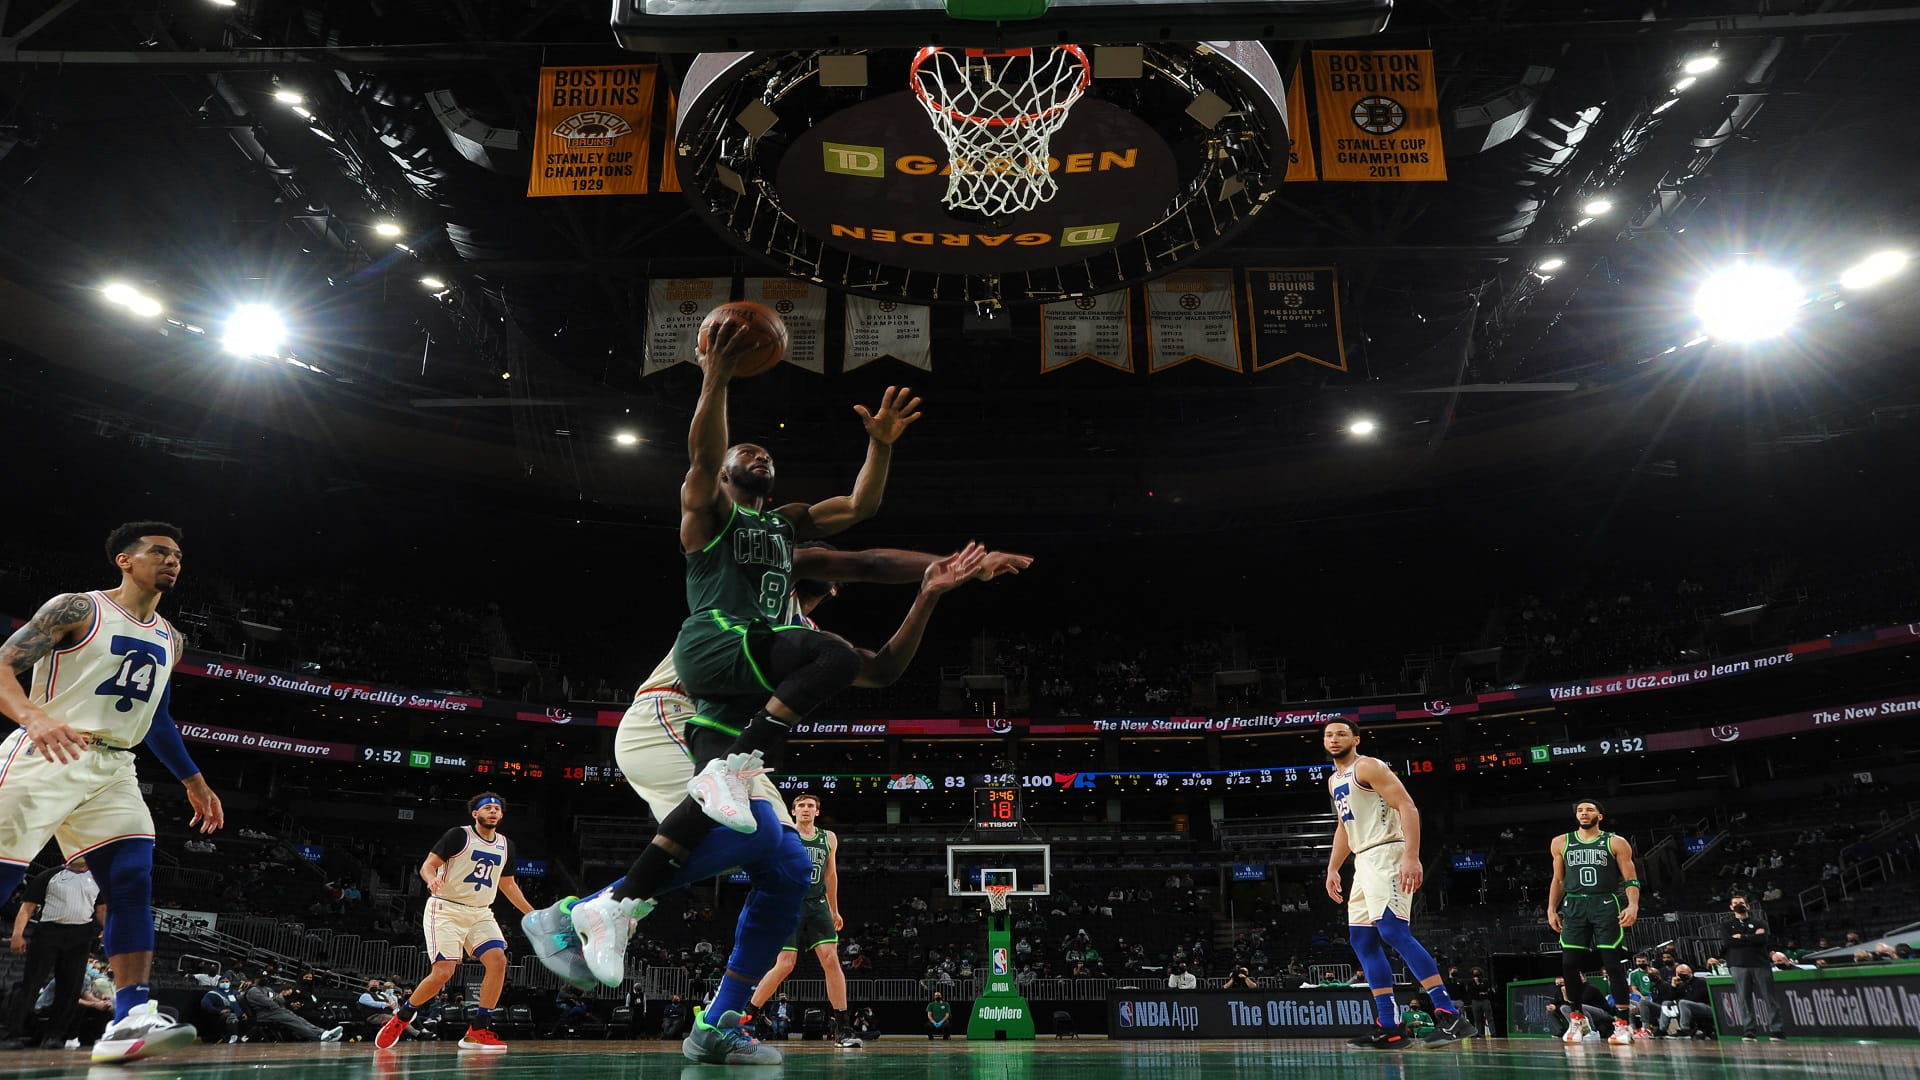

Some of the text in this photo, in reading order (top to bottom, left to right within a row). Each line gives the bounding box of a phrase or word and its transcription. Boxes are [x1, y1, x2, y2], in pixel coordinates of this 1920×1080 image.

[1329, 54, 1419, 72] BOSTON
[555, 69, 641, 87] BOSTON
[1331, 73, 1421, 92] BRUINS
[552, 87, 639, 107] BRUINS
[556, 112, 630, 136] BOSTON
[571, 138, 611, 146] BRUINS
[1338, 138, 1426, 150] STANLEY CUP
[547, 151, 633, 165] STANLEY CUP
[829, 148, 878, 171] TD
[1338, 152, 1429, 164] CHAMPIONS
[545, 165, 633, 178] CHAMPIONS
[1369, 166, 1401, 177] 2011
[572, 179, 604, 191] 1929
[830, 223, 1113, 247] TD GARDEN
[1268, 272, 1314, 281] BOSTON
[1269, 282, 1315, 291] BRUINS
[760, 571, 787, 619] 8
[116, 659, 153, 692] 14
[1550, 652, 1794, 700] Visit us at UG2.com to learn more
[206, 663, 467, 712] The New Standard of Facility Services
[1813, 712, 1841, 725] The
[1844, 705, 1877, 721] New
[796, 723, 886, 733] to learn more
[1093, 720, 1118, 731] The
[1120, 720, 1148, 731] New
[1152, 719, 1212, 730] Standard
[1215, 717, 1231, 730] of
[1232, 715, 1283, 730] Facility
[181, 725, 330, 756] UG2.com to learn more
[1600, 738, 1643, 755] 9:52
[364, 748, 402, 763] 9:52
[412, 753, 467, 767] TD Bank
[1532, 744, 1587, 761] TD Bank
[562, 766, 585, 779] 18
[1411, 760, 1434, 774] 18
[944, 776, 966, 788] 83
[1022, 776, 1052, 788] 100
[1155, 779, 1168, 787] 49
[1182, 778, 1212, 787] 33/68
[1226, 776, 1251, 785] 8/22
[1260, 775, 1273, 783] 13
[1310, 772, 1323, 780] 14
[779, 781, 809, 790] 30/65
[823, 781, 836, 789] 46
[989, 790, 1014, 801] 3:46
[992, 801, 1012, 819] 18
[1567, 849, 1607, 866] CELTICS
[474, 863, 493, 880] 31
[1579, 867, 1598, 887] 0
[992, 982, 1009, 992] @NBA
[979, 1006, 1022, 1021] #OnlyHere
[1228, 1001, 1263, 1027] The
[1267, 1000, 1333, 1026] Official
[1339, 1000, 1375, 1025] NBA
[1785, 990, 1814, 1026] The
[1812, 987, 1867, 1026] Official
[1863, 986, 1902, 1026] NBA
[1135, 1001, 1199, 1031] NBA App
